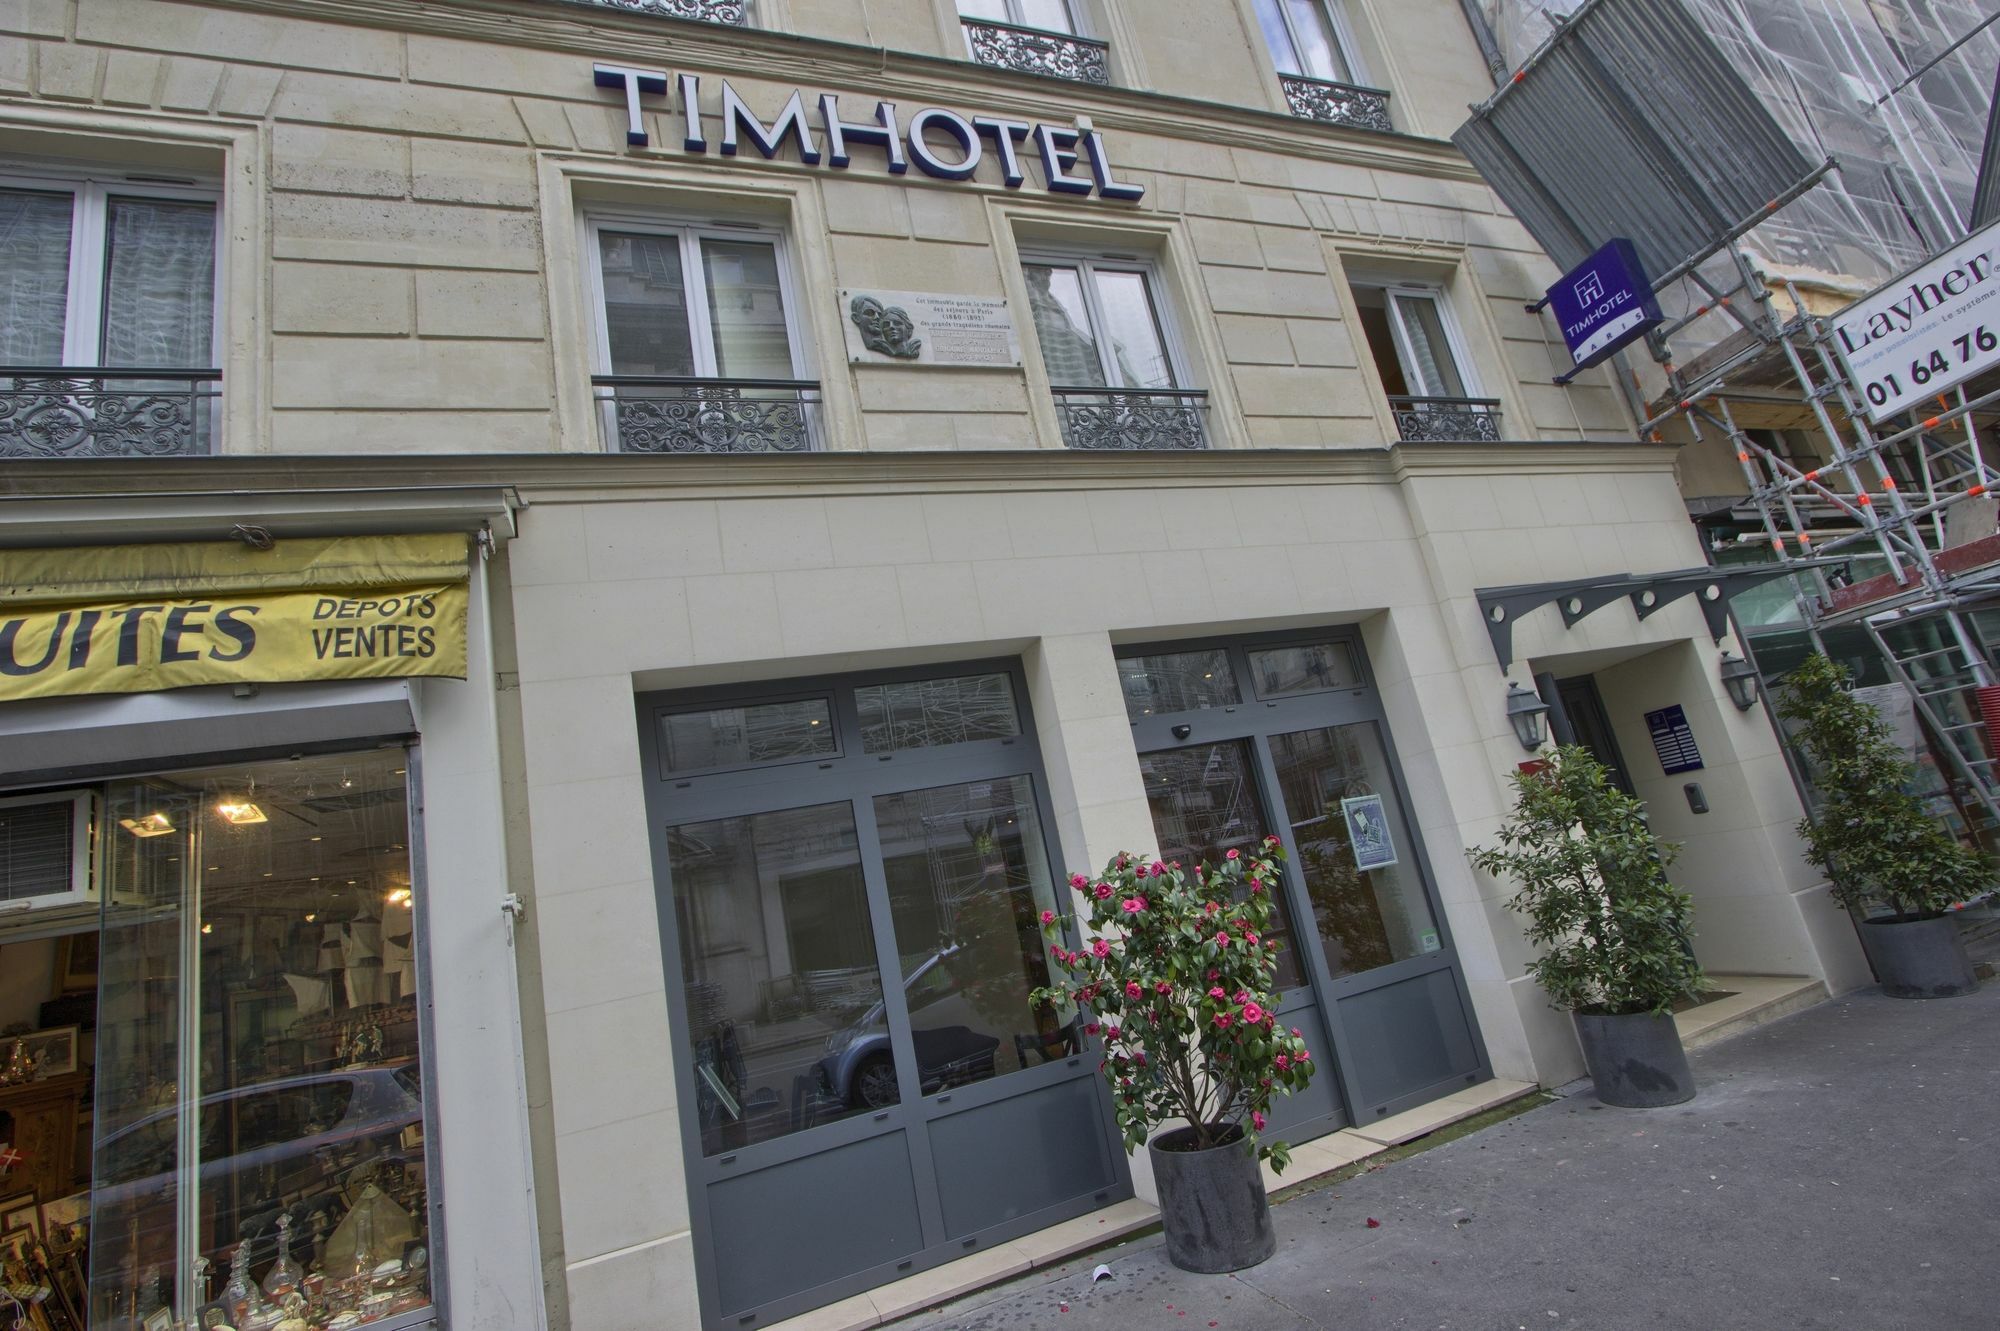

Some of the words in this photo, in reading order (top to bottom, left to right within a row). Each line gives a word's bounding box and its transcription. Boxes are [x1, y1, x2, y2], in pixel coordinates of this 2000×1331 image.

[593, 63, 1145, 200] TIMHOTEL
[1566, 289, 1632, 337] TIMHOTEL
[1836, 253, 1990, 356] Layher
[1941, 312, 1954, 322] Le
[1956, 289, 1997, 315] système
[1576, 312, 1641, 361] PARIS
[1866, 374, 1902, 406] 01
[1911, 349, 1949, 385] 64
[1952, 325, 1998, 363] 76
[312, 624, 436, 660] VENTES
